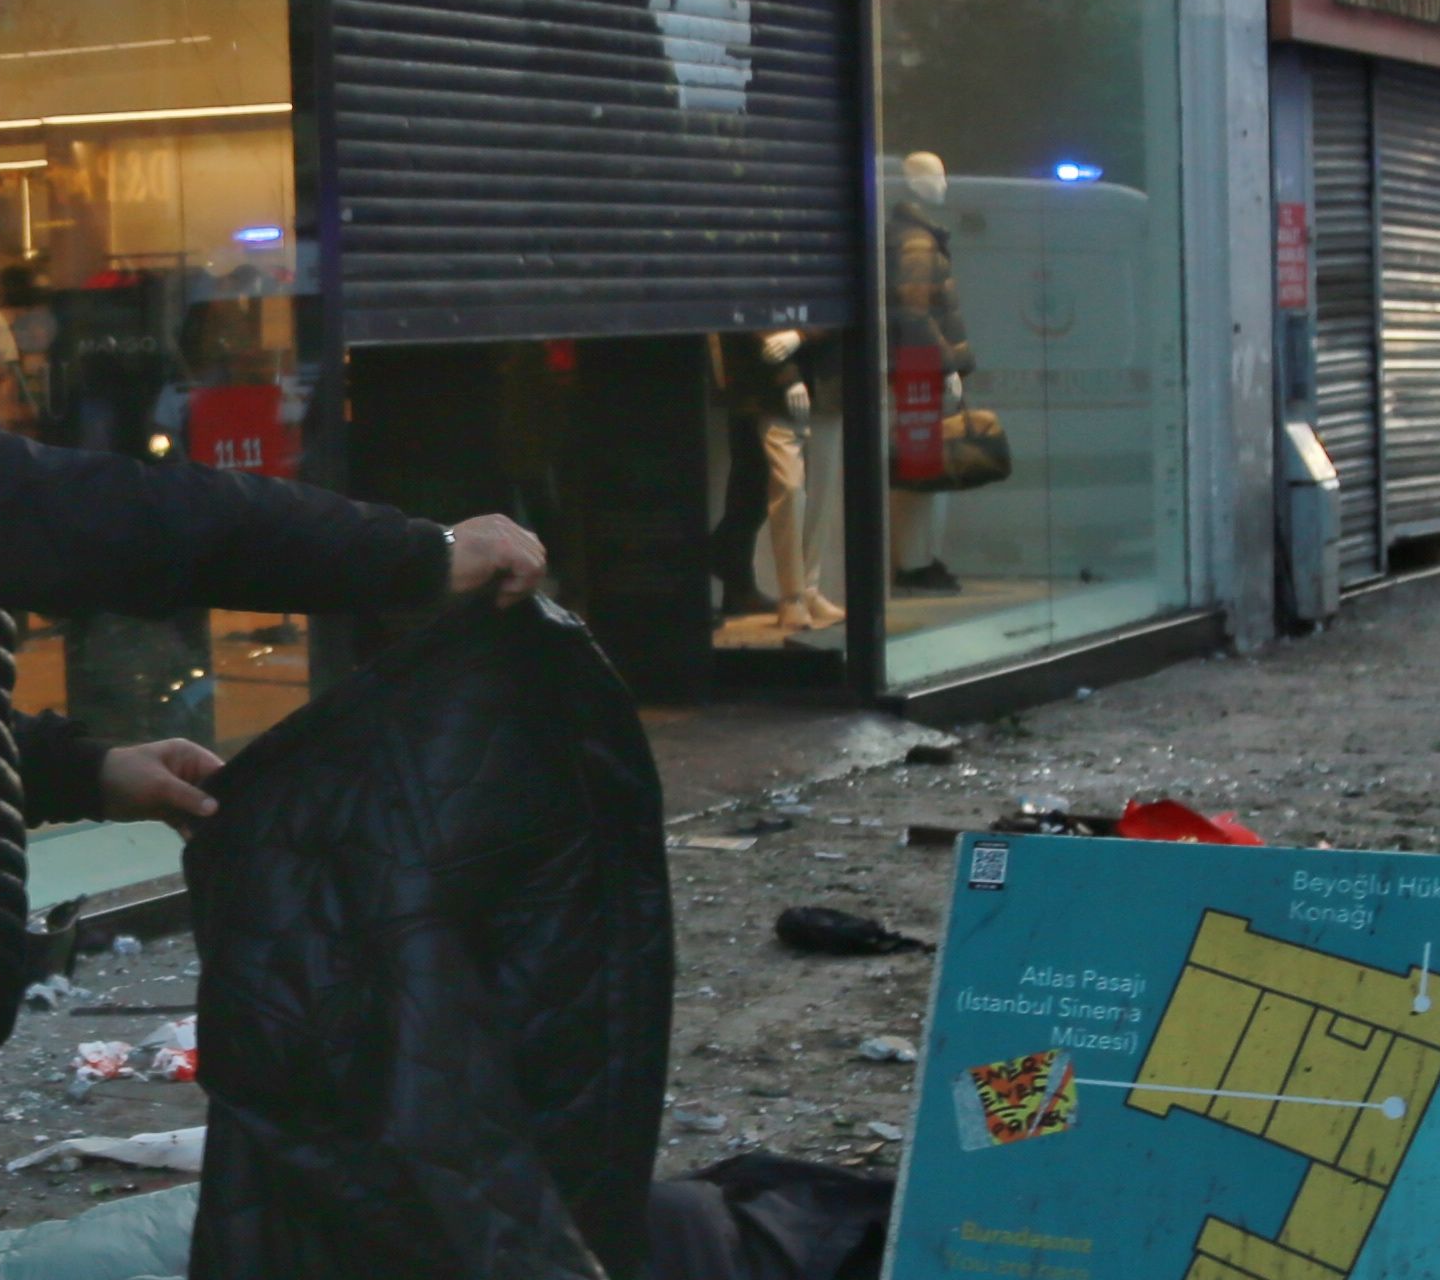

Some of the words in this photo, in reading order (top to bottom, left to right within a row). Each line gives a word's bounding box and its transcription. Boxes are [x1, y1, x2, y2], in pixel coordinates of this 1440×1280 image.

[215, 437, 263, 469] 11.11
[1293, 870, 1391, 900] Beyoğlu
[1288, 900, 1375, 930] Konağı
[1020, 965, 1076, 988] Atlas
[1081, 969, 1147, 998] Pasajı
[957, 986, 1053, 1016] (İstanbul
[1058, 997, 1142, 1023] Sinema
[1050, 1025, 1139, 1055] Müzesi)
